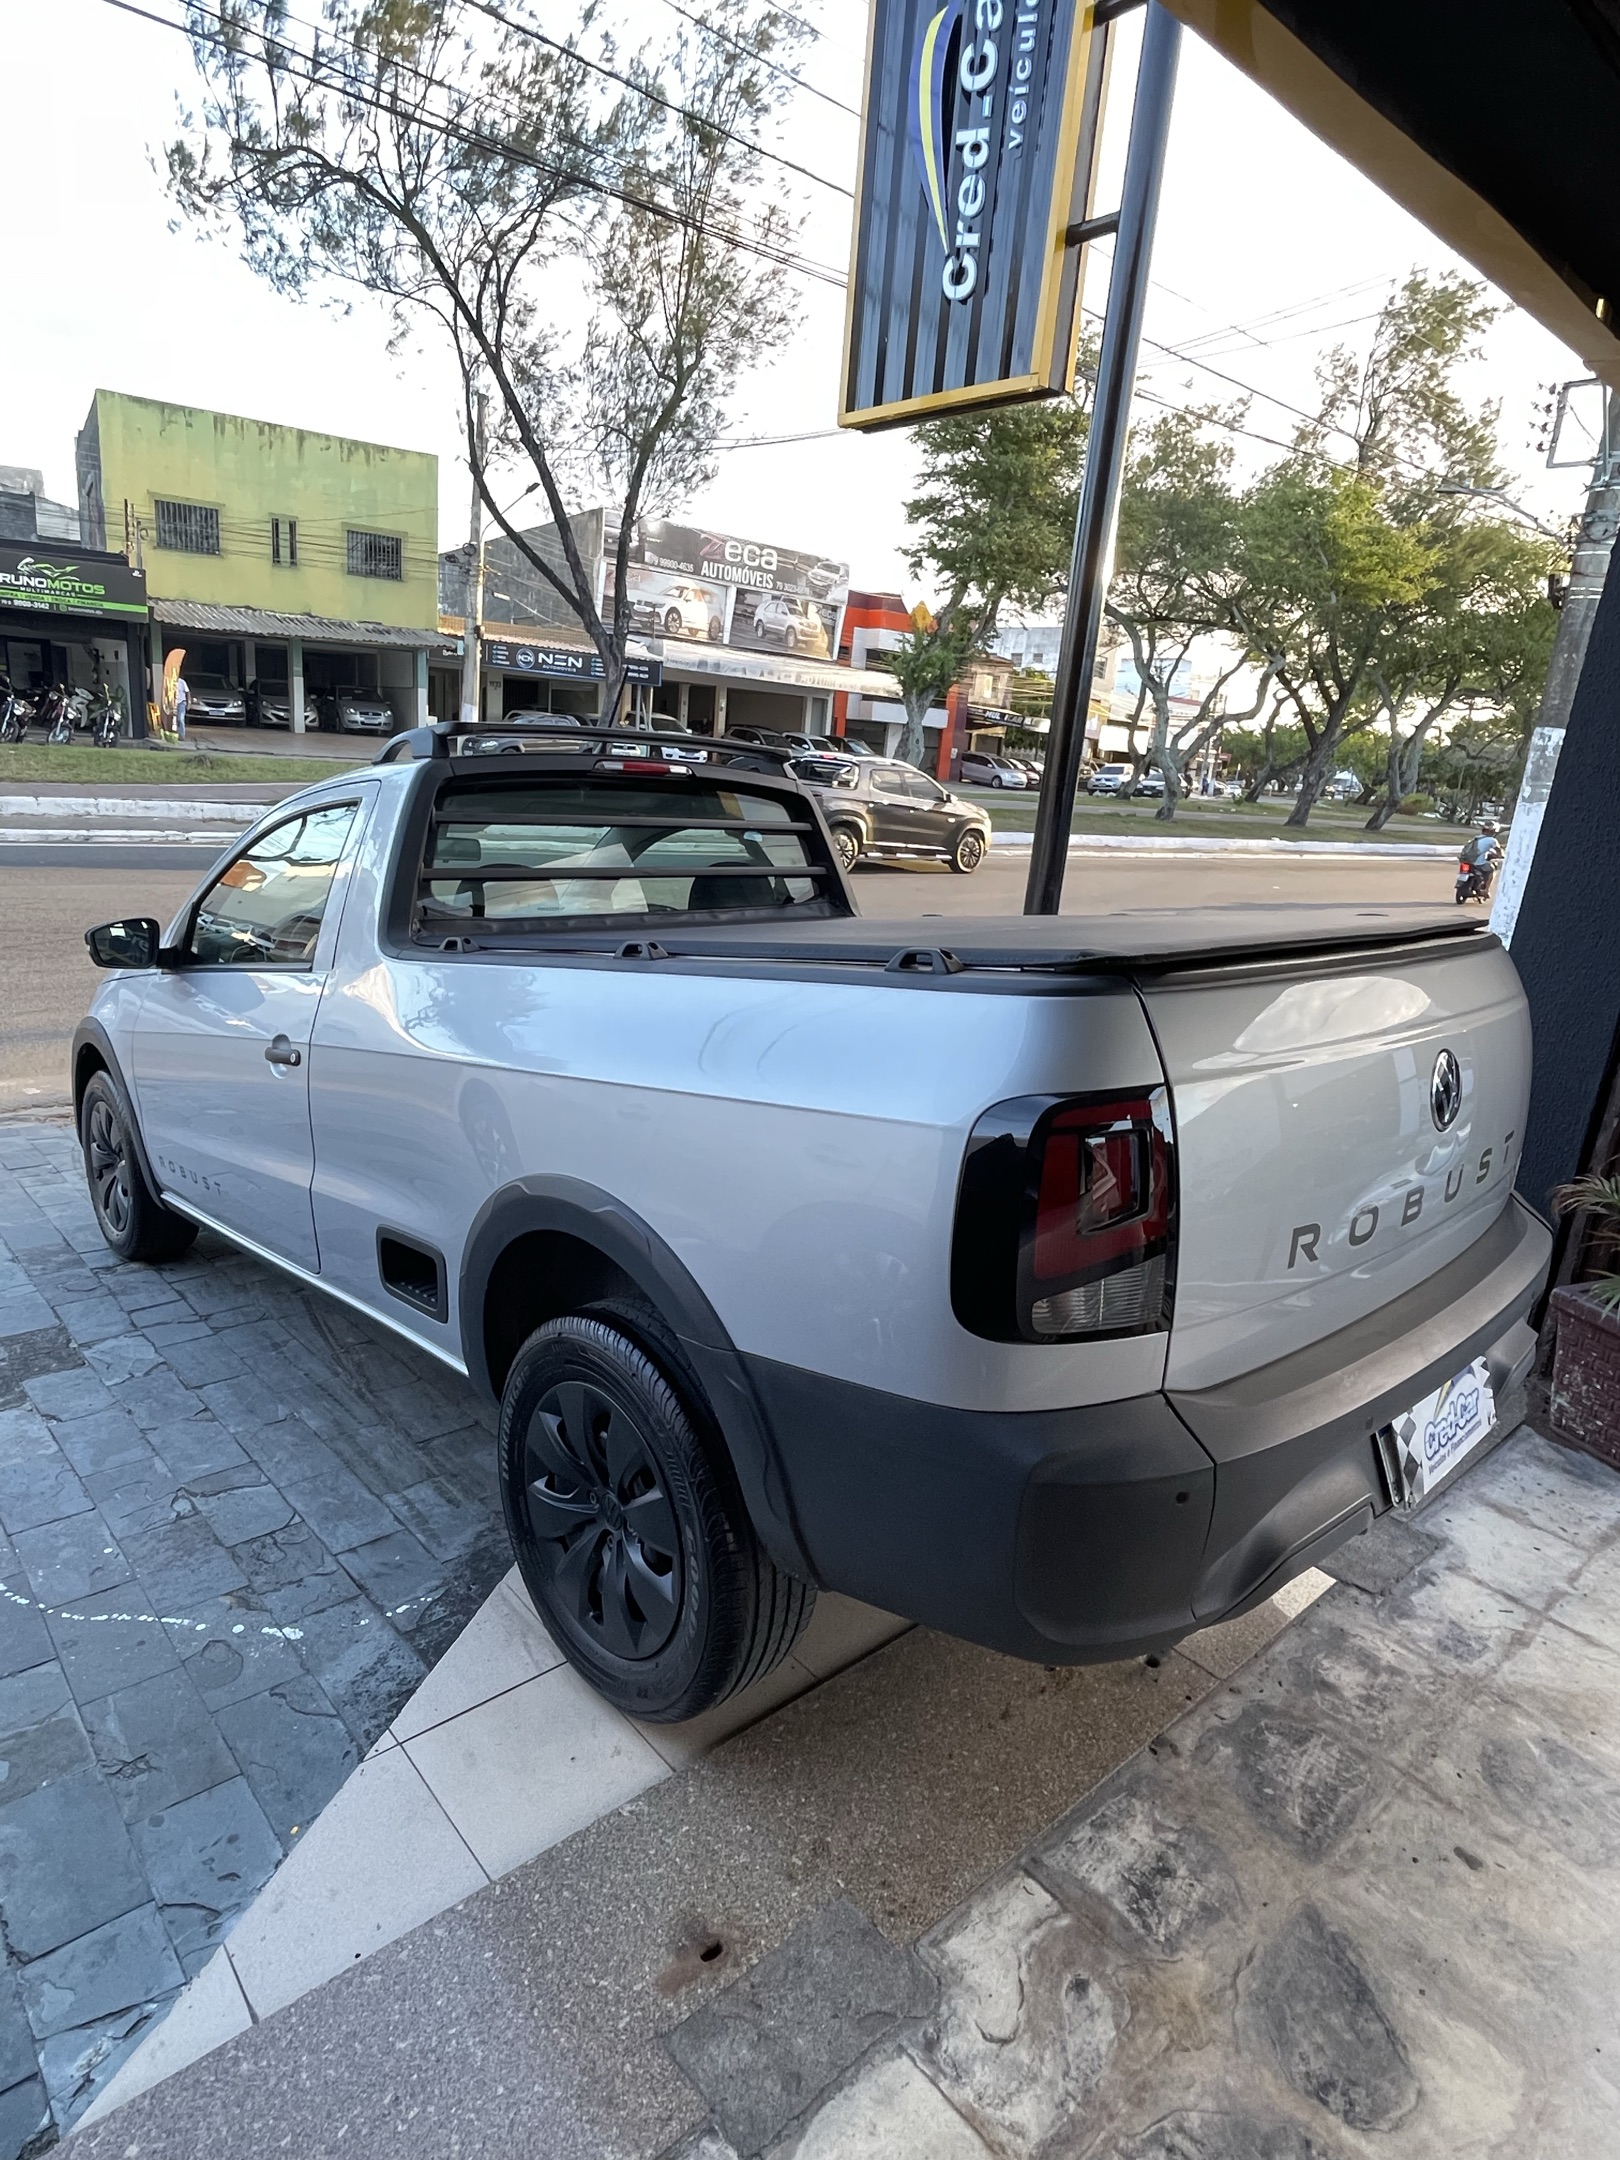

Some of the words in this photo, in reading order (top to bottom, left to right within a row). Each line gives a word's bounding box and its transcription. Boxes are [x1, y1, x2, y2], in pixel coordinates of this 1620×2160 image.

[20, 587, 75, 597] MULTIMARCAS
[701, 560, 773, 590] AUTOMÓVEIS
[159, 1155, 222, 1196] ROBUST
[1287, 1130, 1515, 1271] ROBUST
